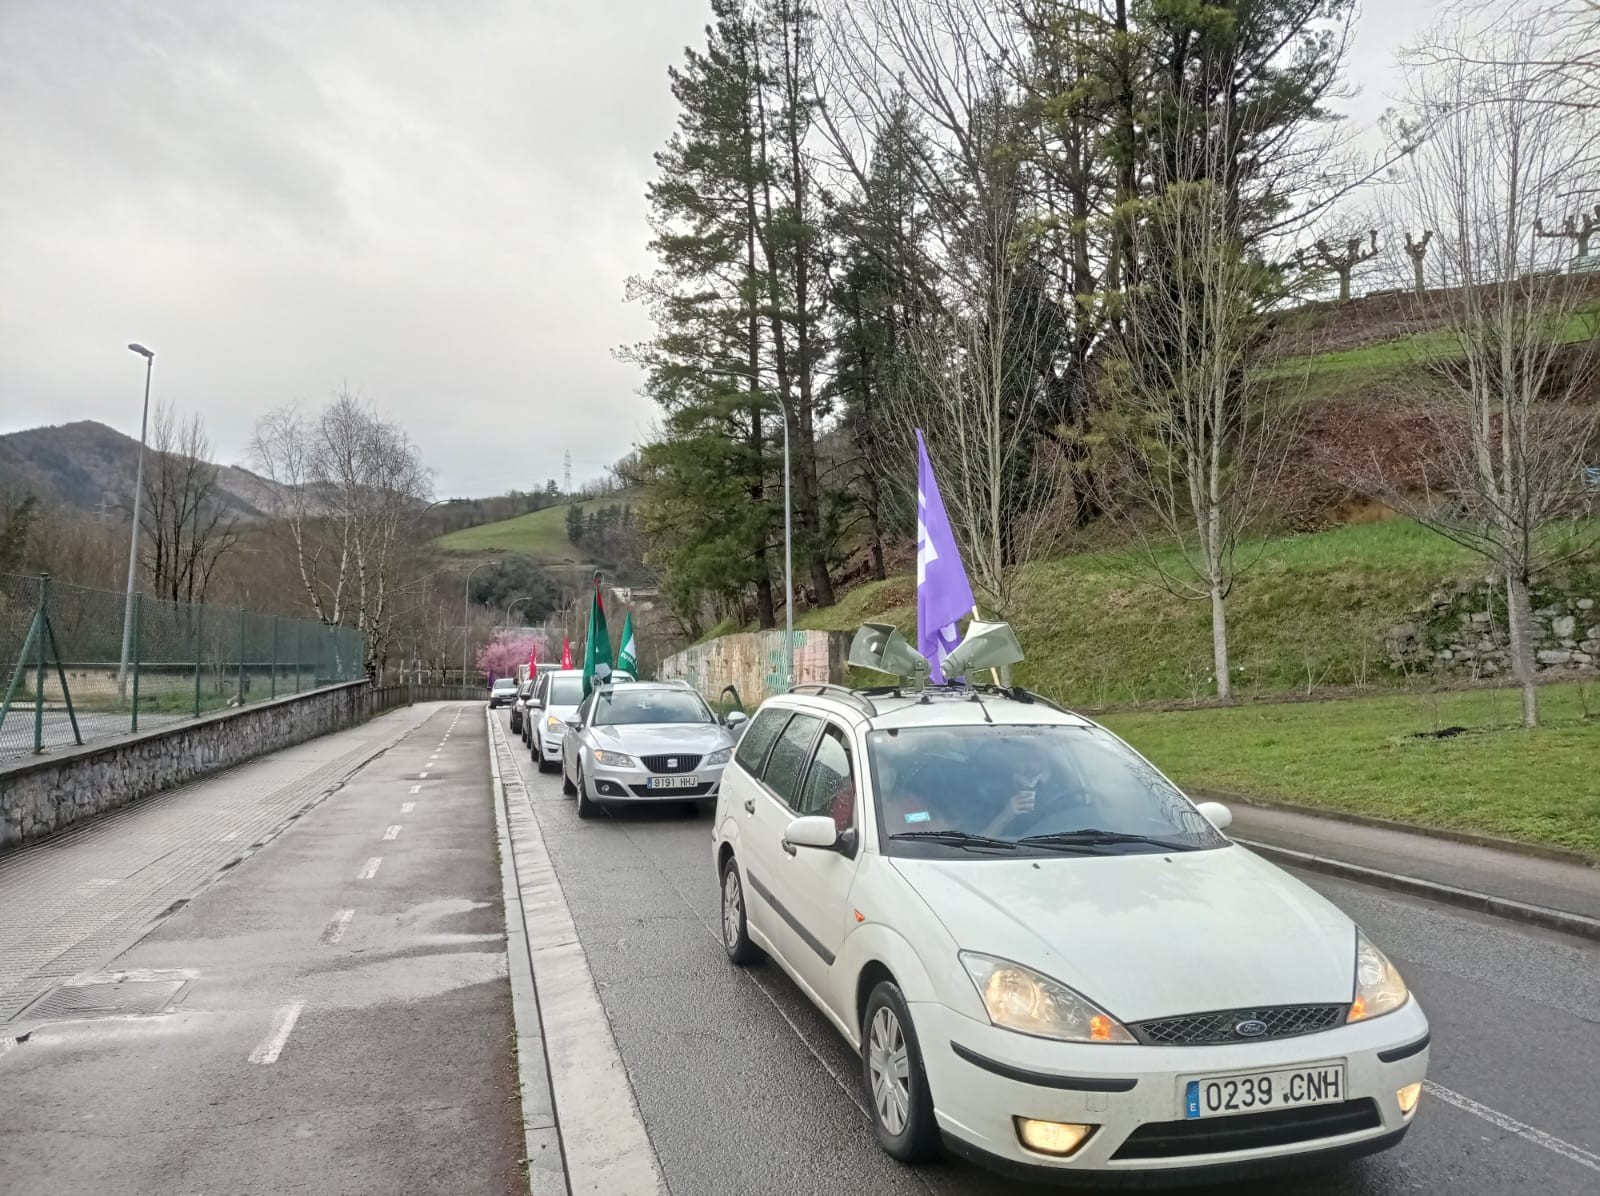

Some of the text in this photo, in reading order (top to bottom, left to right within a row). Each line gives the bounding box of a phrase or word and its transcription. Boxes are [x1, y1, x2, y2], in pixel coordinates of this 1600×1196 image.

[654, 777, 696, 787] 9191 HHJ
[1206, 1076, 1273, 1112] 0239
[1289, 1069, 1340, 1102] CNH
